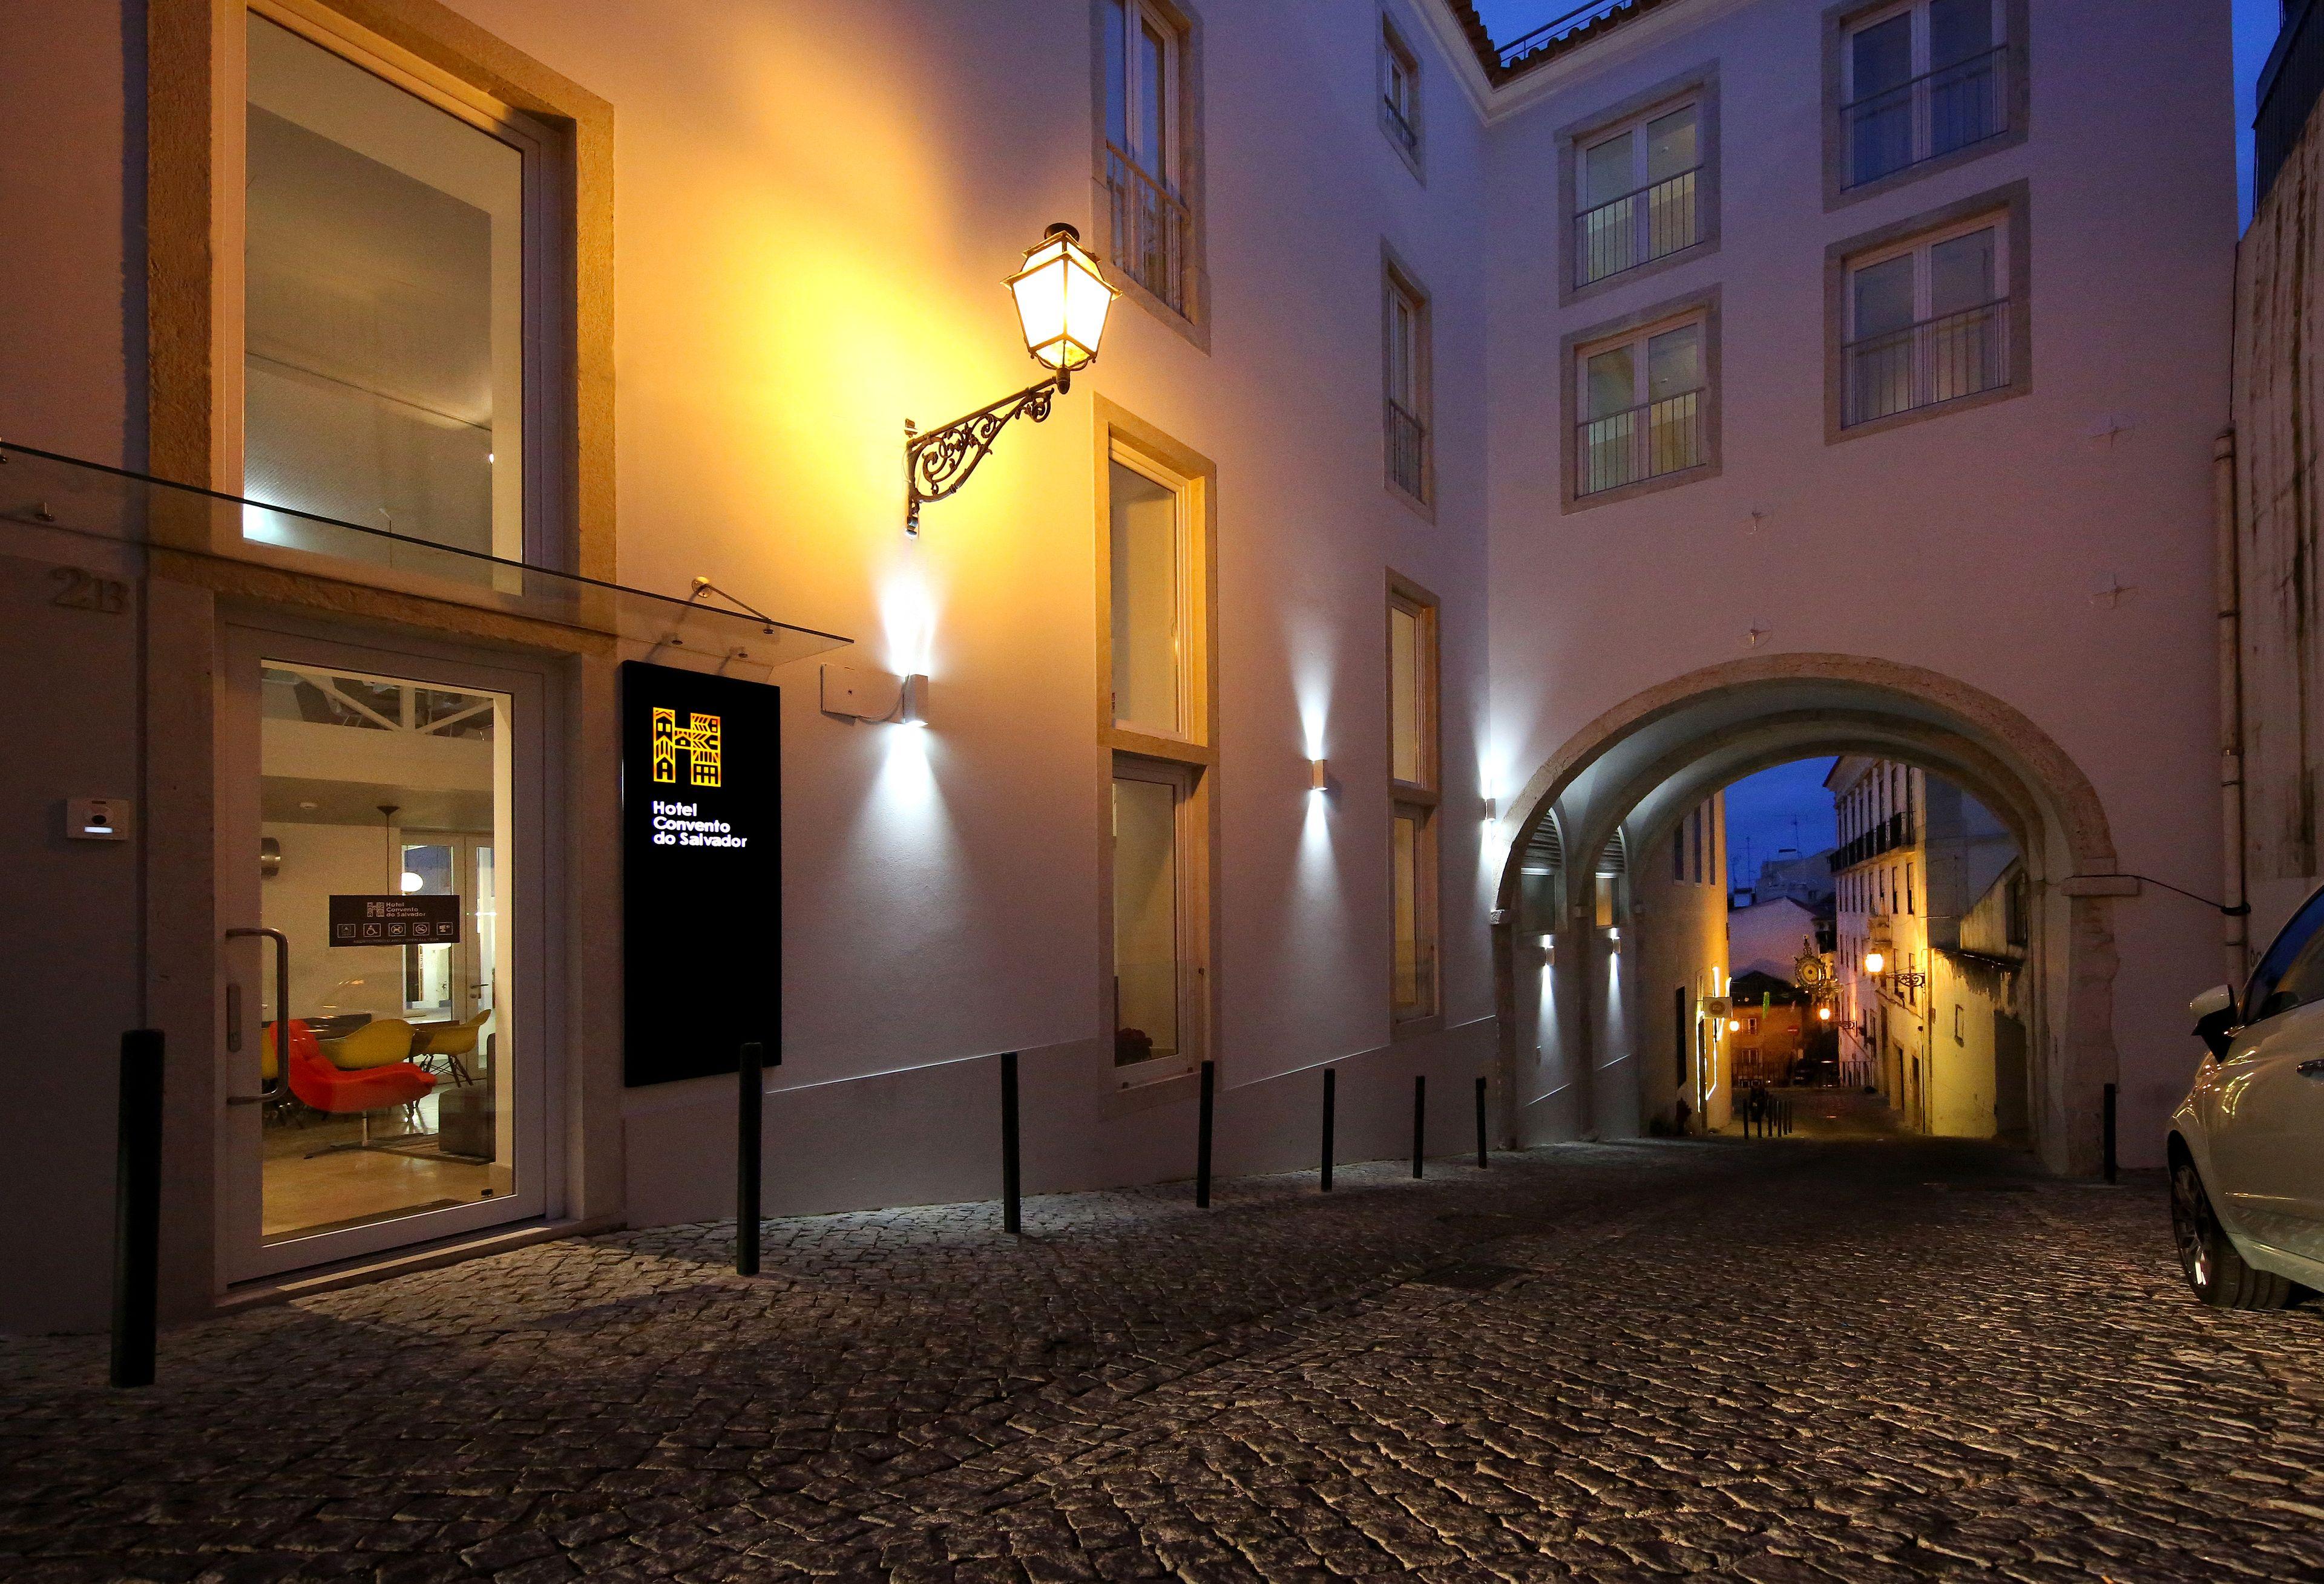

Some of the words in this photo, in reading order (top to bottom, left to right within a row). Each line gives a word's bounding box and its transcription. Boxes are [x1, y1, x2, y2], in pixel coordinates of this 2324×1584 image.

[653, 800, 697, 817] Hotel
[653, 816, 730, 833] Convento
[653, 832, 676, 845] do
[679, 832, 747, 848] Salvador
